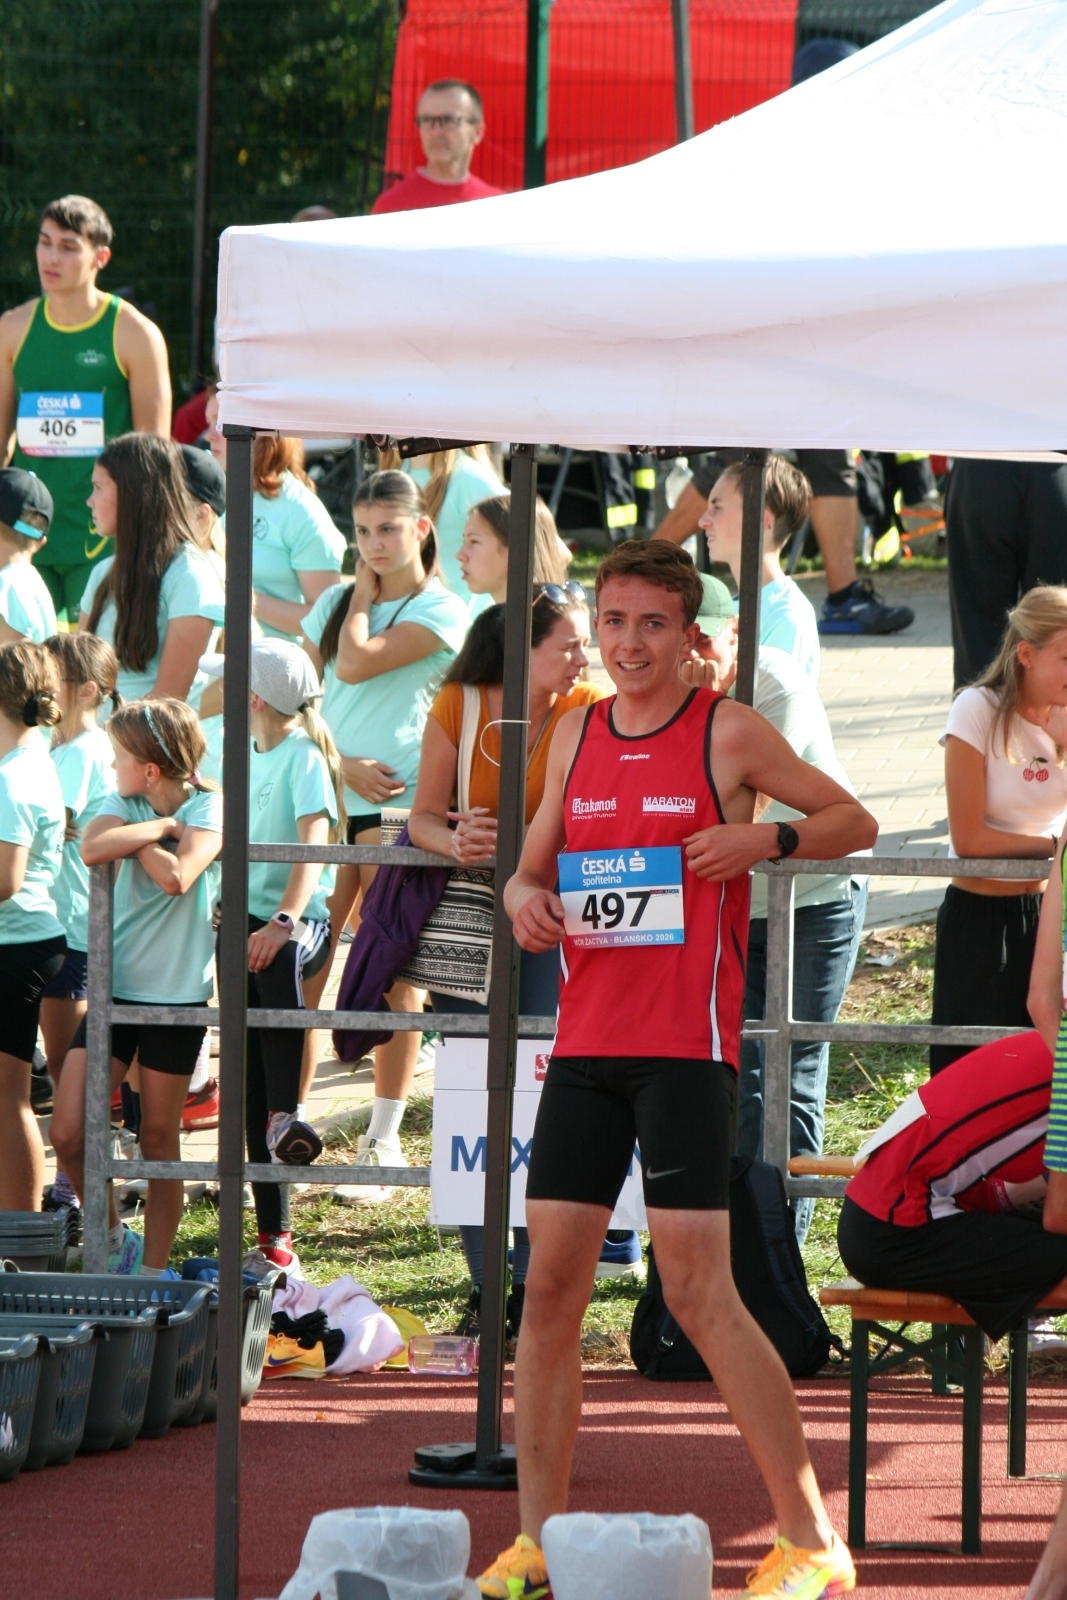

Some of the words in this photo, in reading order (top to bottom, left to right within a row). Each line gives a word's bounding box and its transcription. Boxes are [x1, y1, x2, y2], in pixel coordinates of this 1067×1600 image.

[40, 420, 76, 437] 406
[572, 797, 617, 814] Krakonoš
[642, 796, 696, 806] MARATON
[582, 855, 627, 875] ČESKÁ
[582, 876, 622, 888] spořitelna
[581, 892, 651, 930] 497
[585, 937, 609, 946] ŽACTVA
[613, 933, 654, 944] BLANSKO
[655, 933, 675, 941] 2026
[451, 1135, 534, 1173] MX
